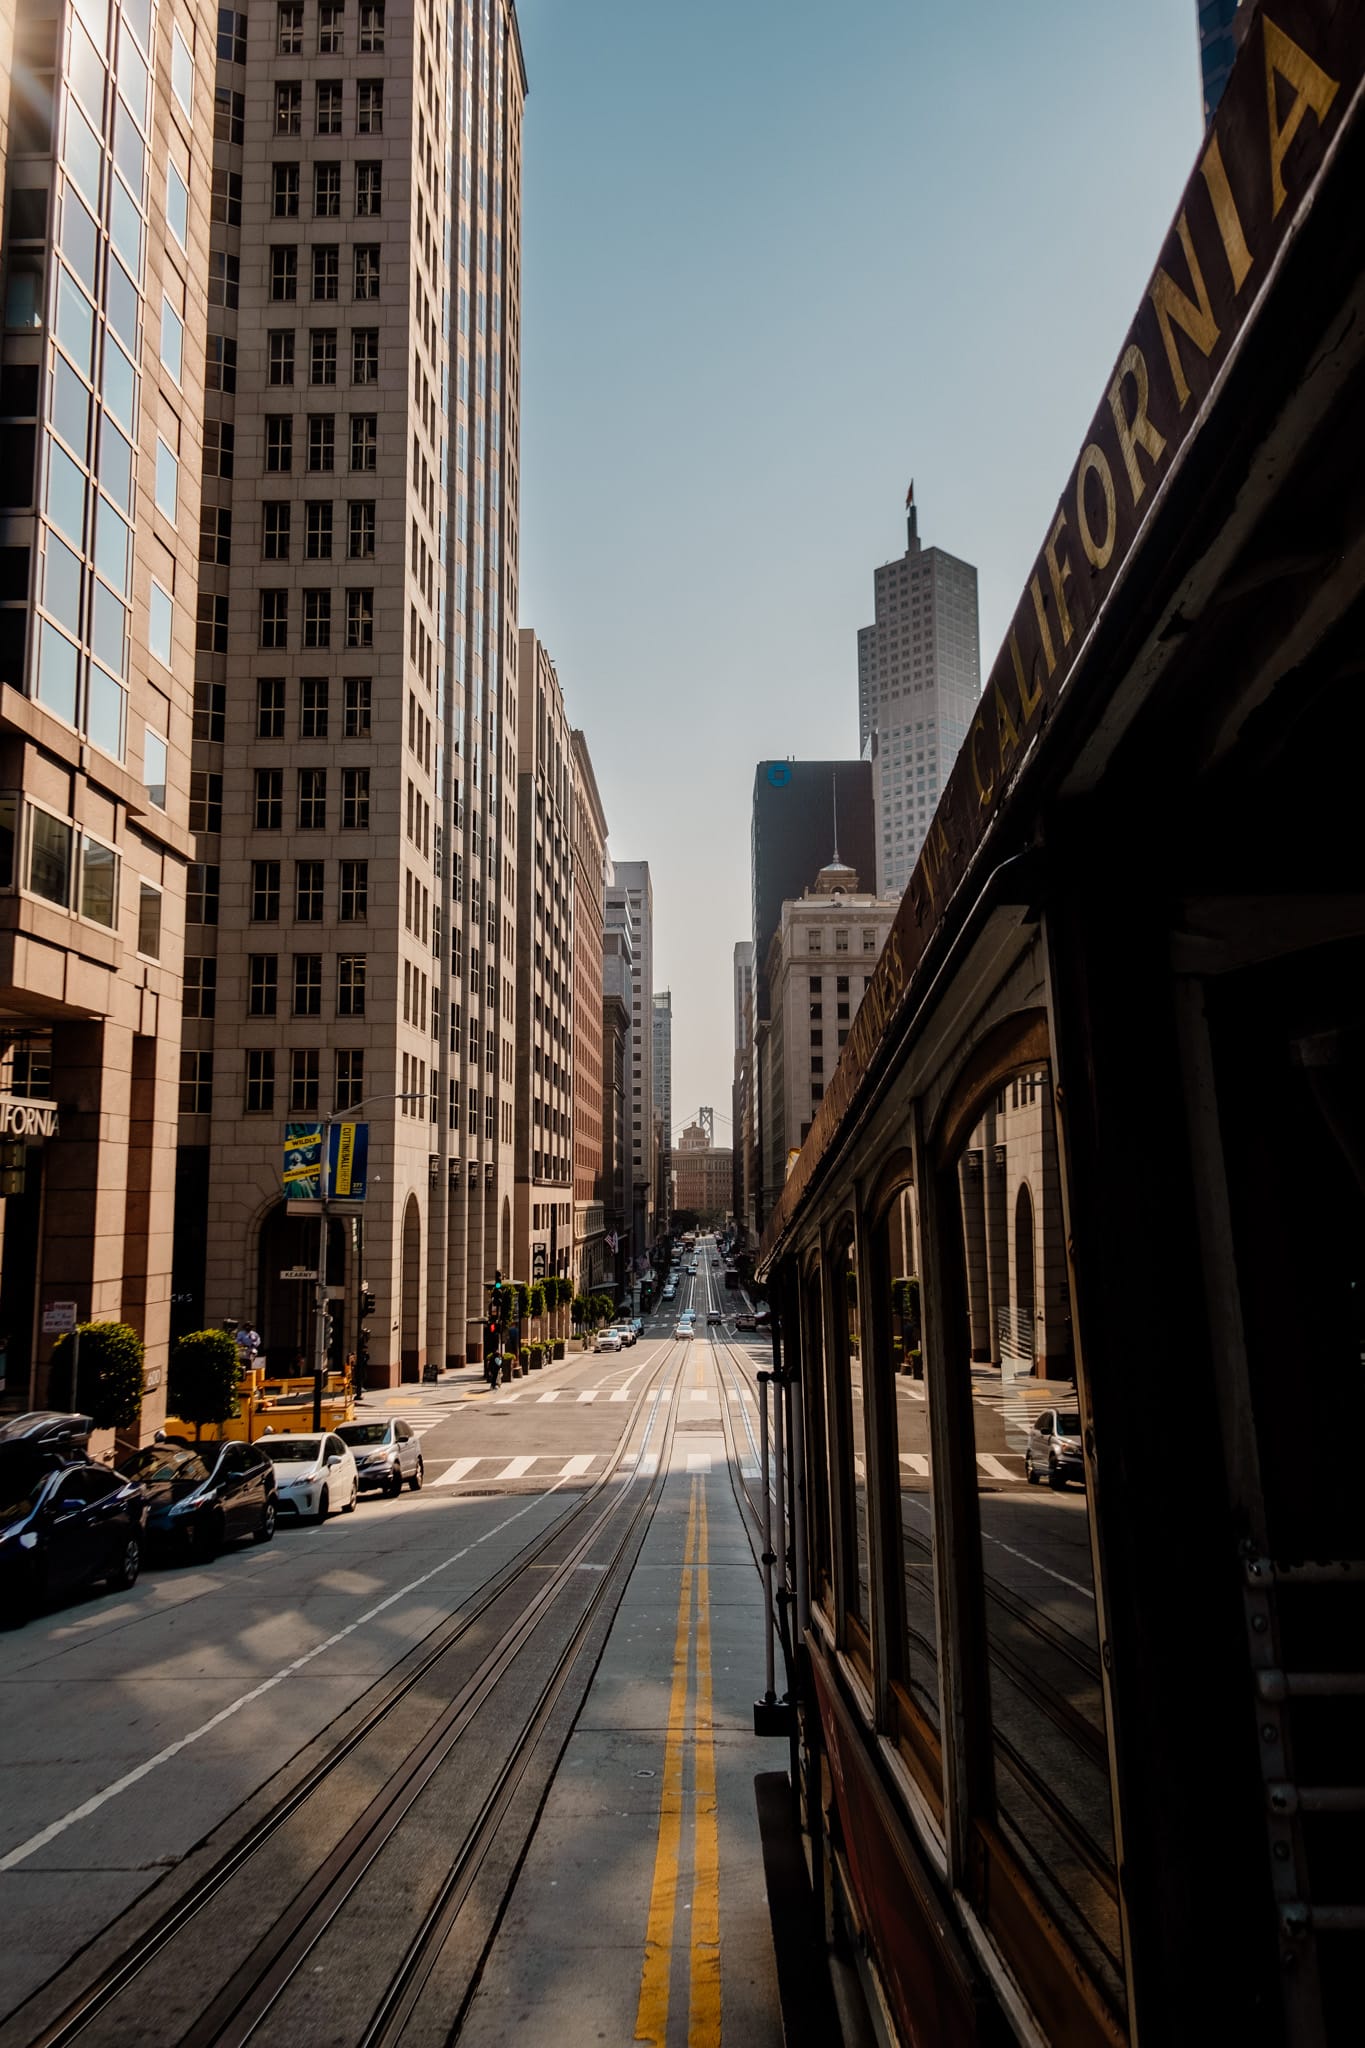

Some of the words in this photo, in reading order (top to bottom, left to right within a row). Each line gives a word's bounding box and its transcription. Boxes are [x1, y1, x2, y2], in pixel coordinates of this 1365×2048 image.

[921, 816, 949, 911] VIA
[970, 13, 1341, 806] CALIFORNIA
[291, 1137, 317, 1146] WILDLY
